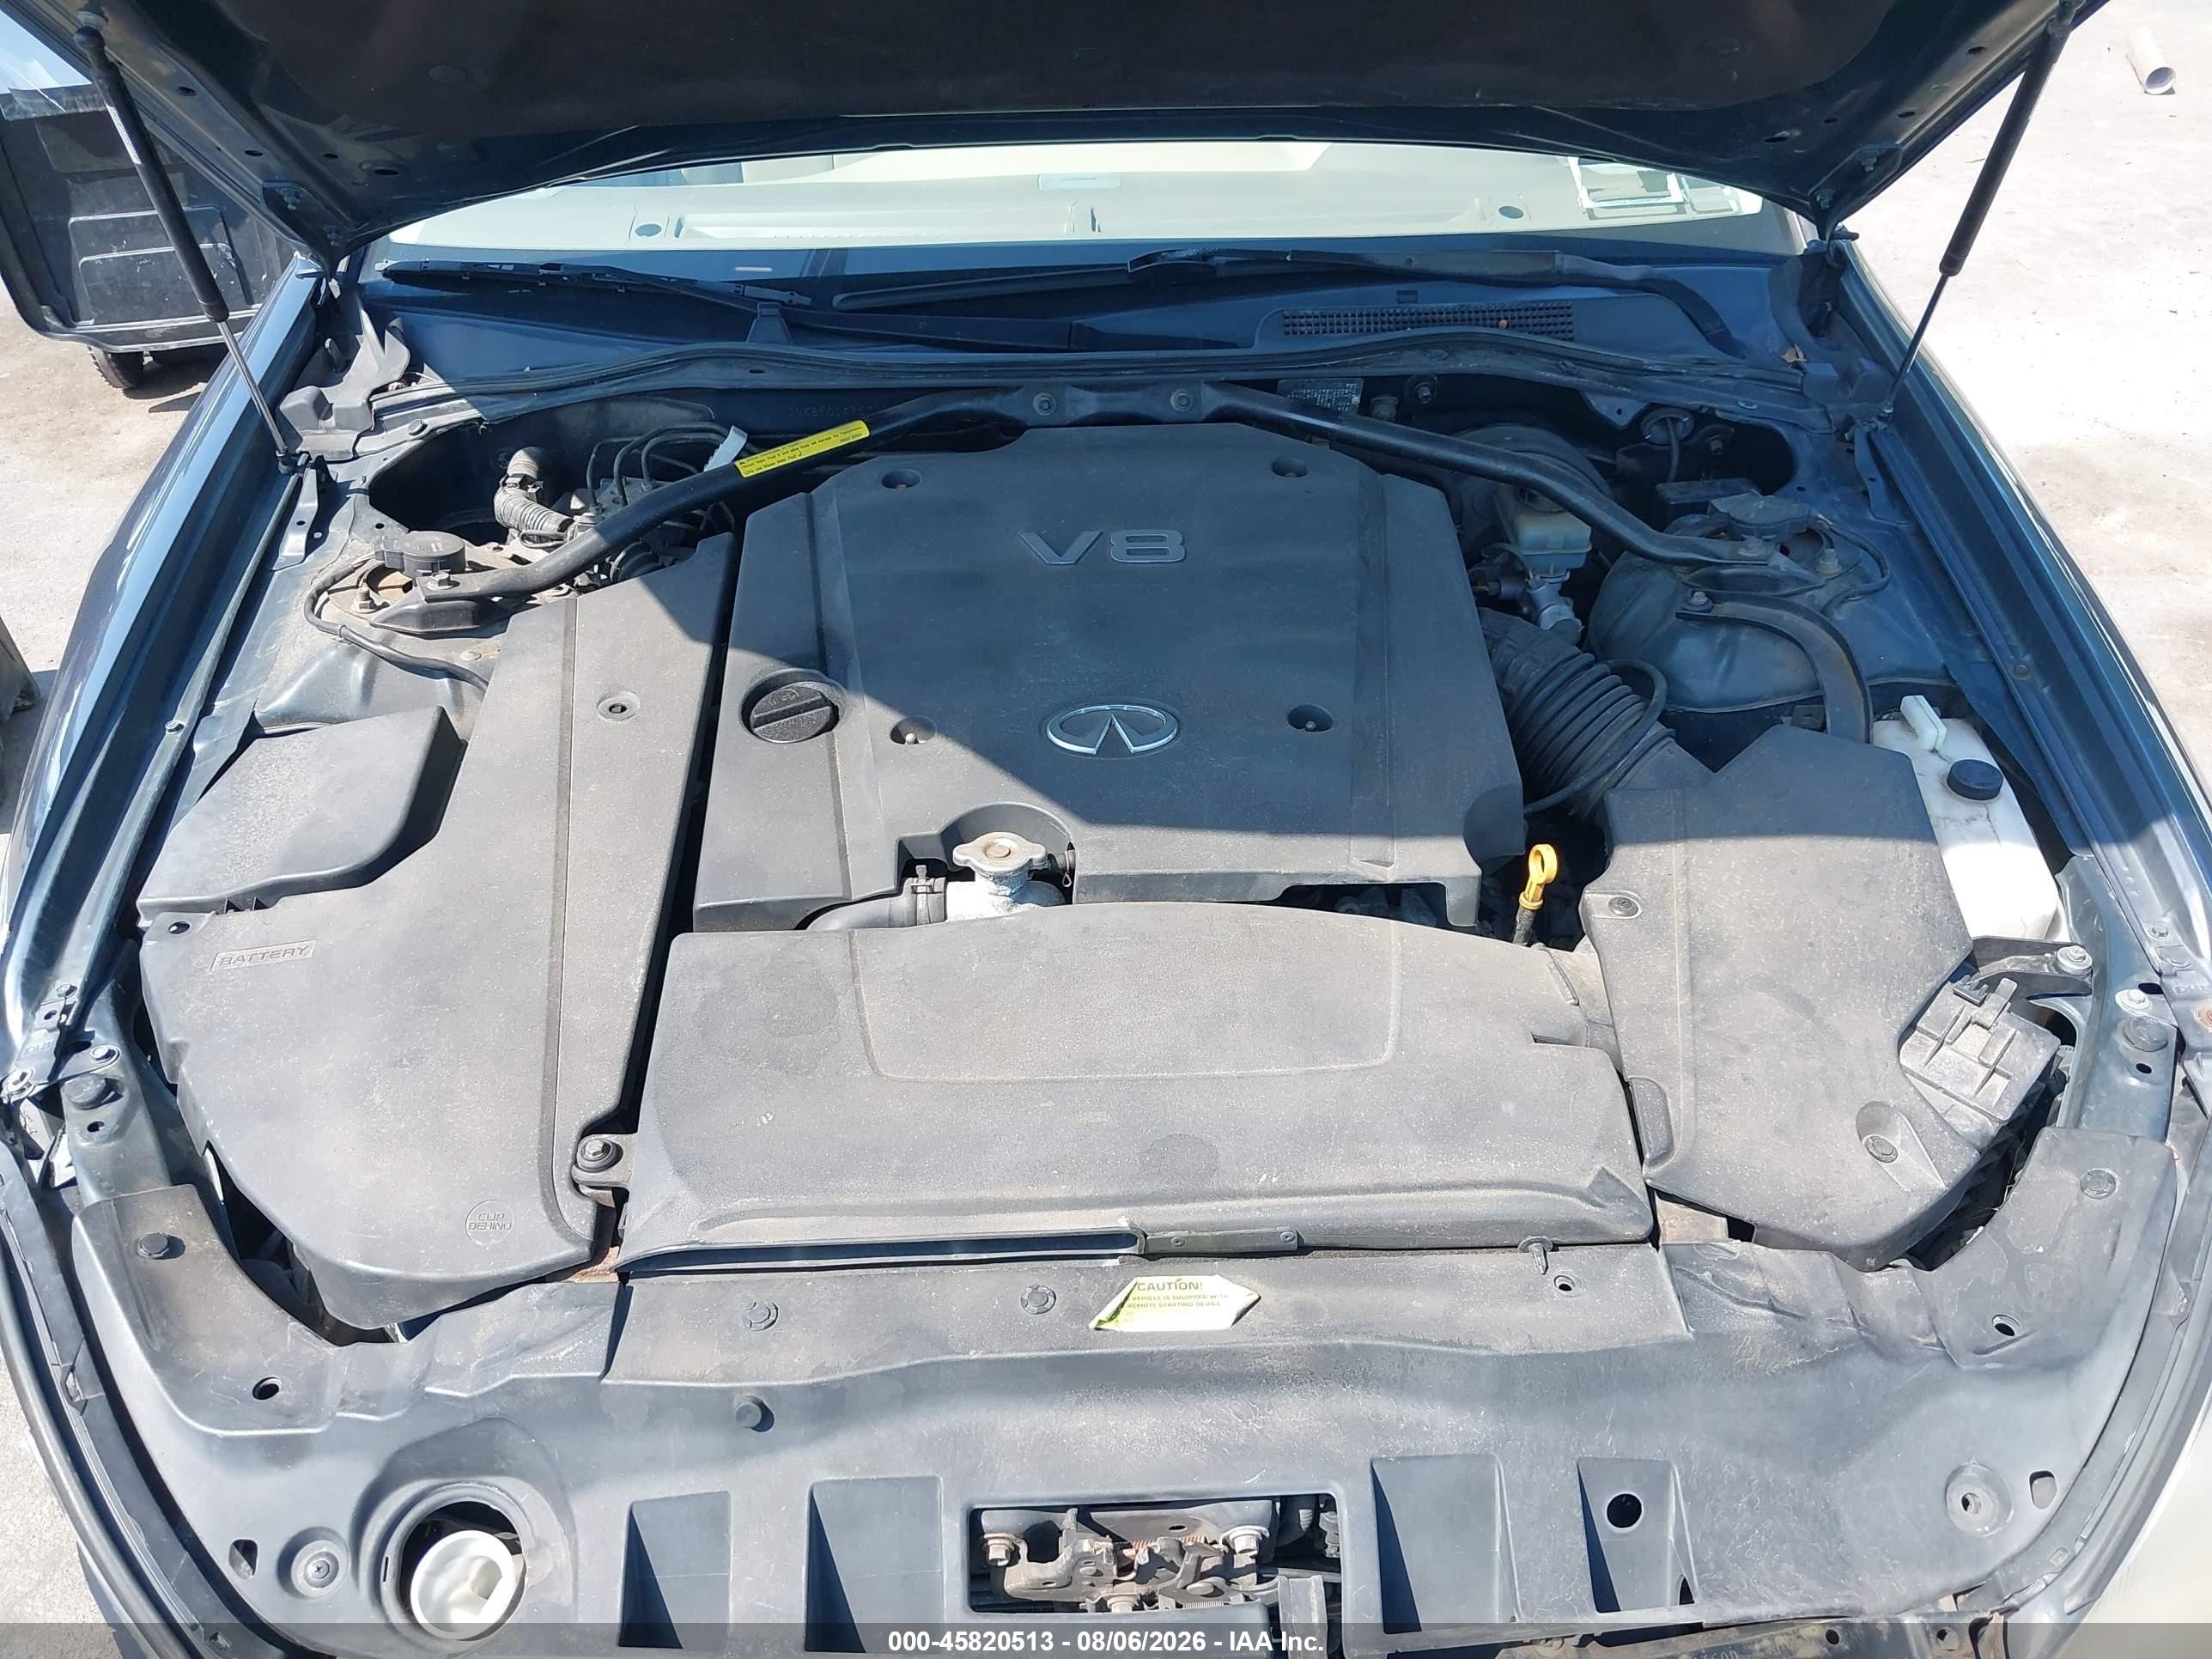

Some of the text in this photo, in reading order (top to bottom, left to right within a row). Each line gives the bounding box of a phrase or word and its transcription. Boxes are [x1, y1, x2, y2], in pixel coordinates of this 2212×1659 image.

[1018, 529, 1186, 564] V8
[220, 945, 310, 965] BATTERY
[1137, 1278, 1203, 1291] CAUTION!
